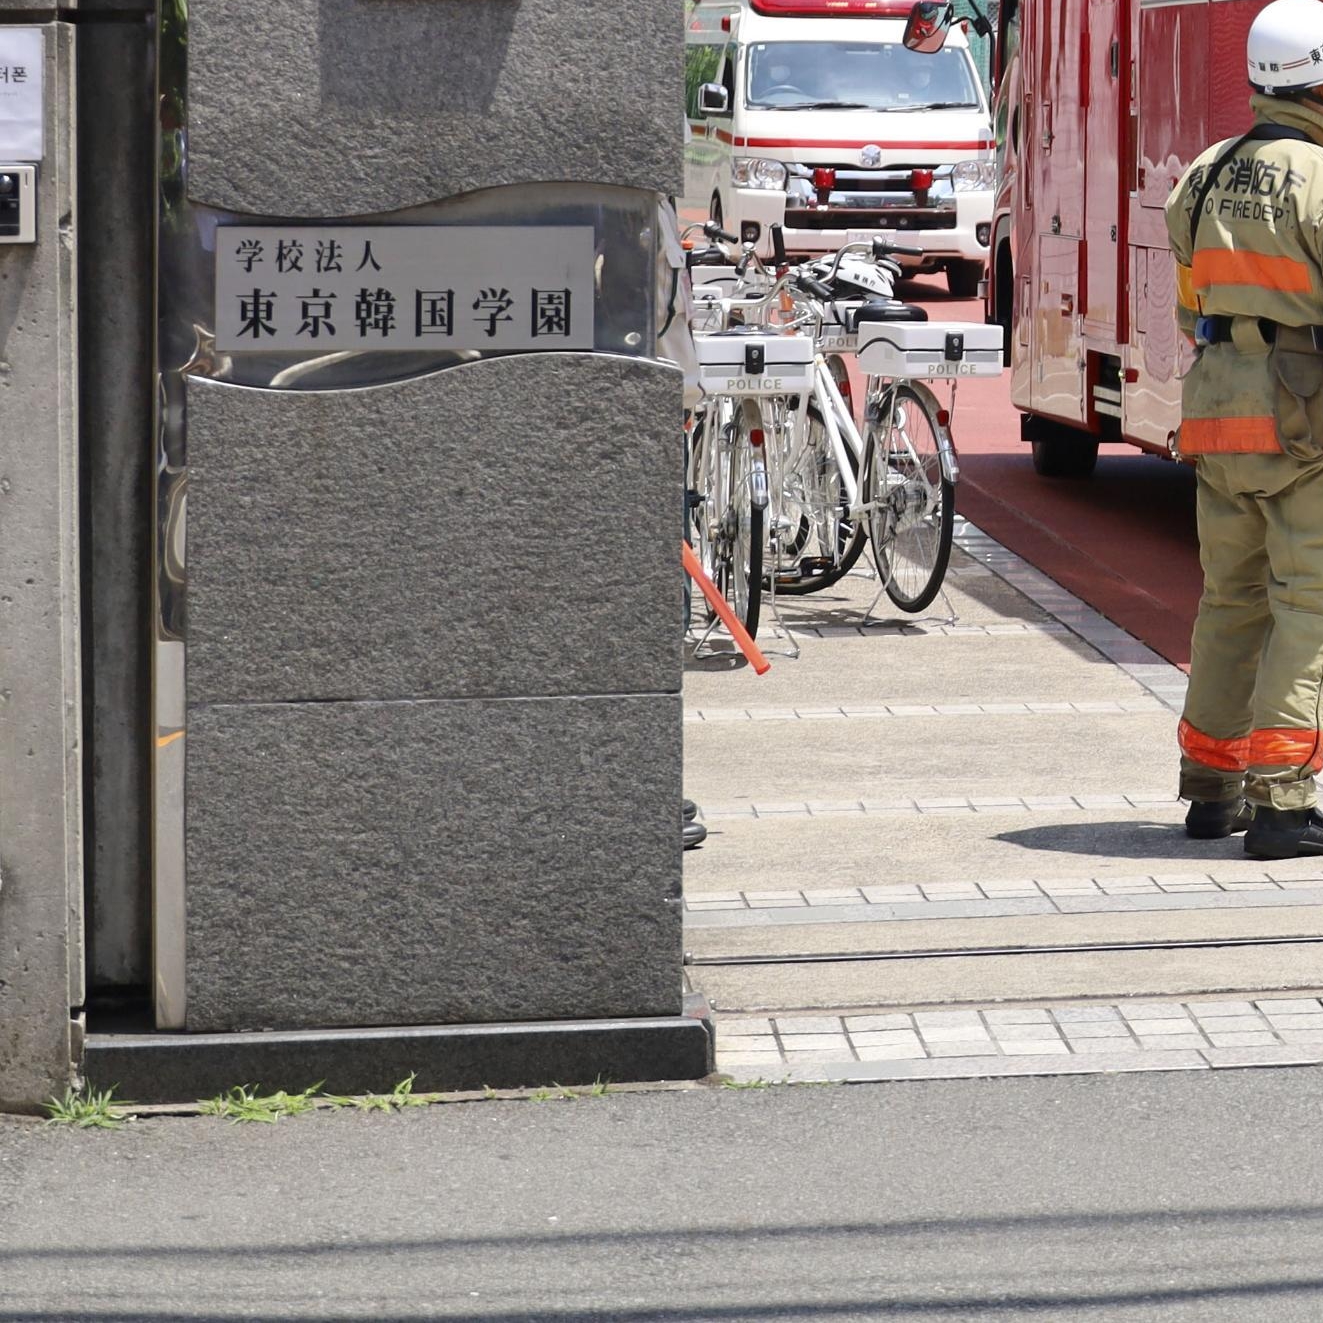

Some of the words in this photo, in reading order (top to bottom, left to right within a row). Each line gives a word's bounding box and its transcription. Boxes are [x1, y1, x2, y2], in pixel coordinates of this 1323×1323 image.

[1186, 157, 1306, 203] 東消防庁
[1218, 198, 1251, 219] FIRE
[235, 238, 382, 273] 学校法人
[236, 286, 573, 339] 東京韓国学園
[927, 364, 977, 375] POLICE
[727, 378, 782, 390] POLICE
